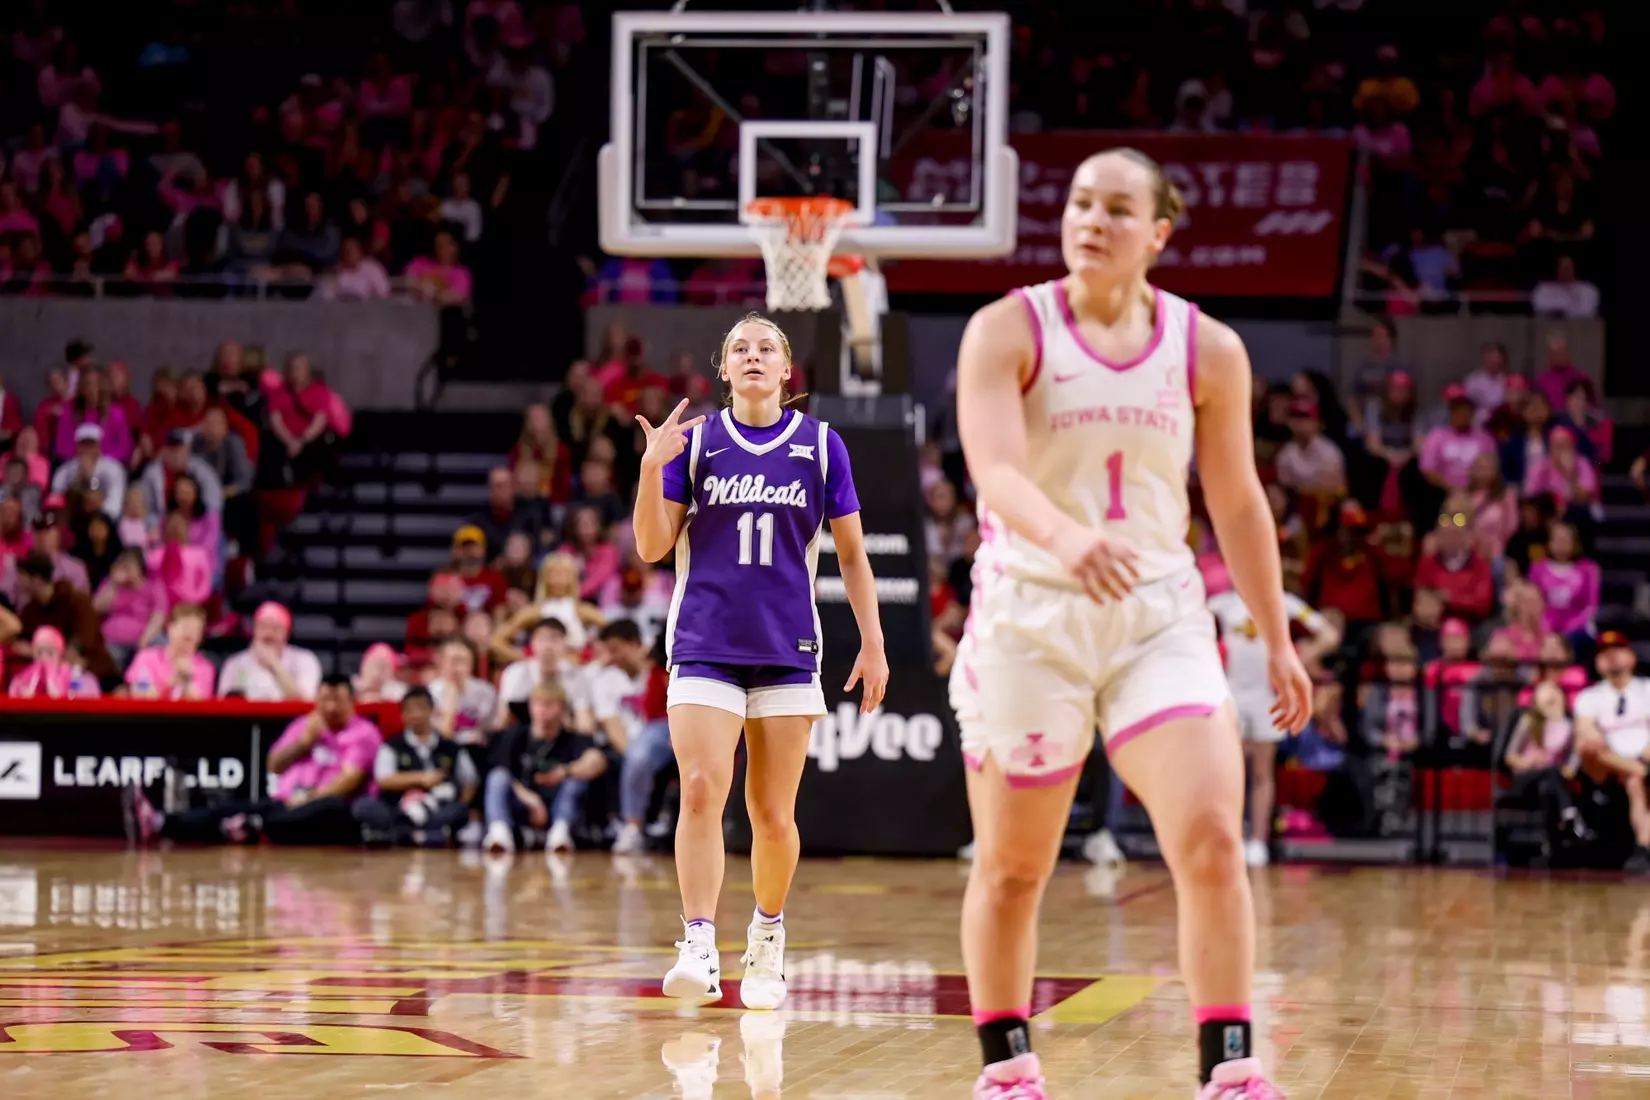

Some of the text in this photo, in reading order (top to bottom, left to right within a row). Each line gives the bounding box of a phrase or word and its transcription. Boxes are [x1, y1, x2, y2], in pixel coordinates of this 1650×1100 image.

[1049, 404, 1111, 431] IOWA
[703, 473, 807, 508] Wildcats
[1105, 451, 1127, 520] 1
[737, 511, 774, 566] 11
[54, 755, 244, 788] LEARFILD
